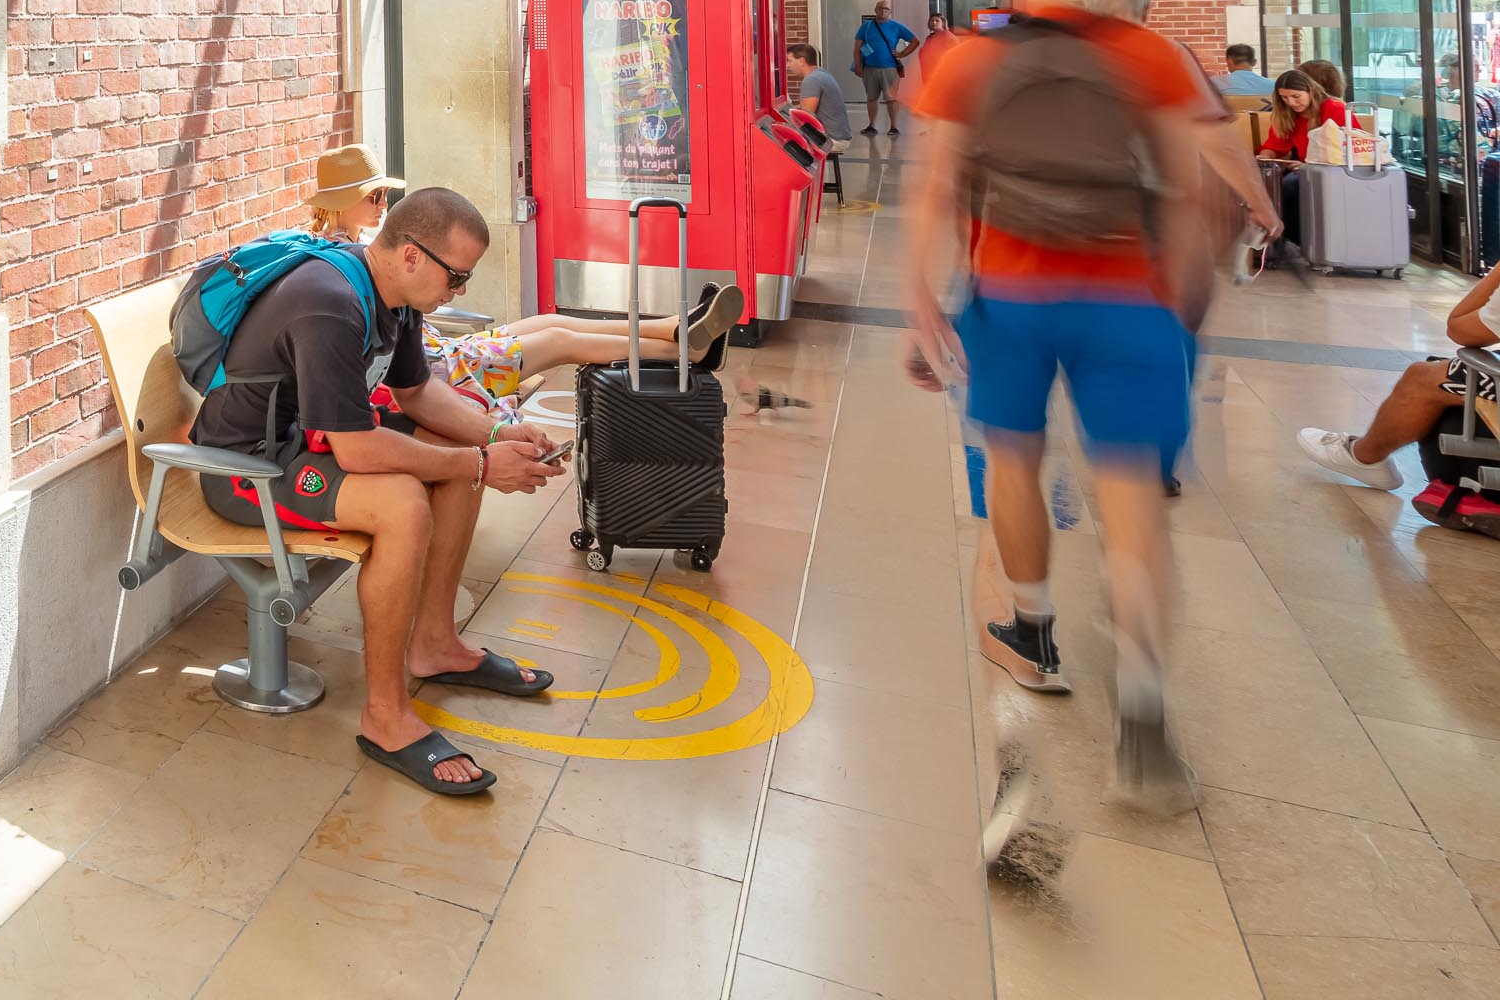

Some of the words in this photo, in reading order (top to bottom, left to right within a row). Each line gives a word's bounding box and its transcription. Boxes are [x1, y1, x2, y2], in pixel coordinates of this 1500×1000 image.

[594, 0, 672, 20] HARIBO
[600, 50, 654, 69] HARIBO
[625, 144, 637, 154] du
[623, 159, 639, 169] ton
[642, 158, 672, 171] trajet
